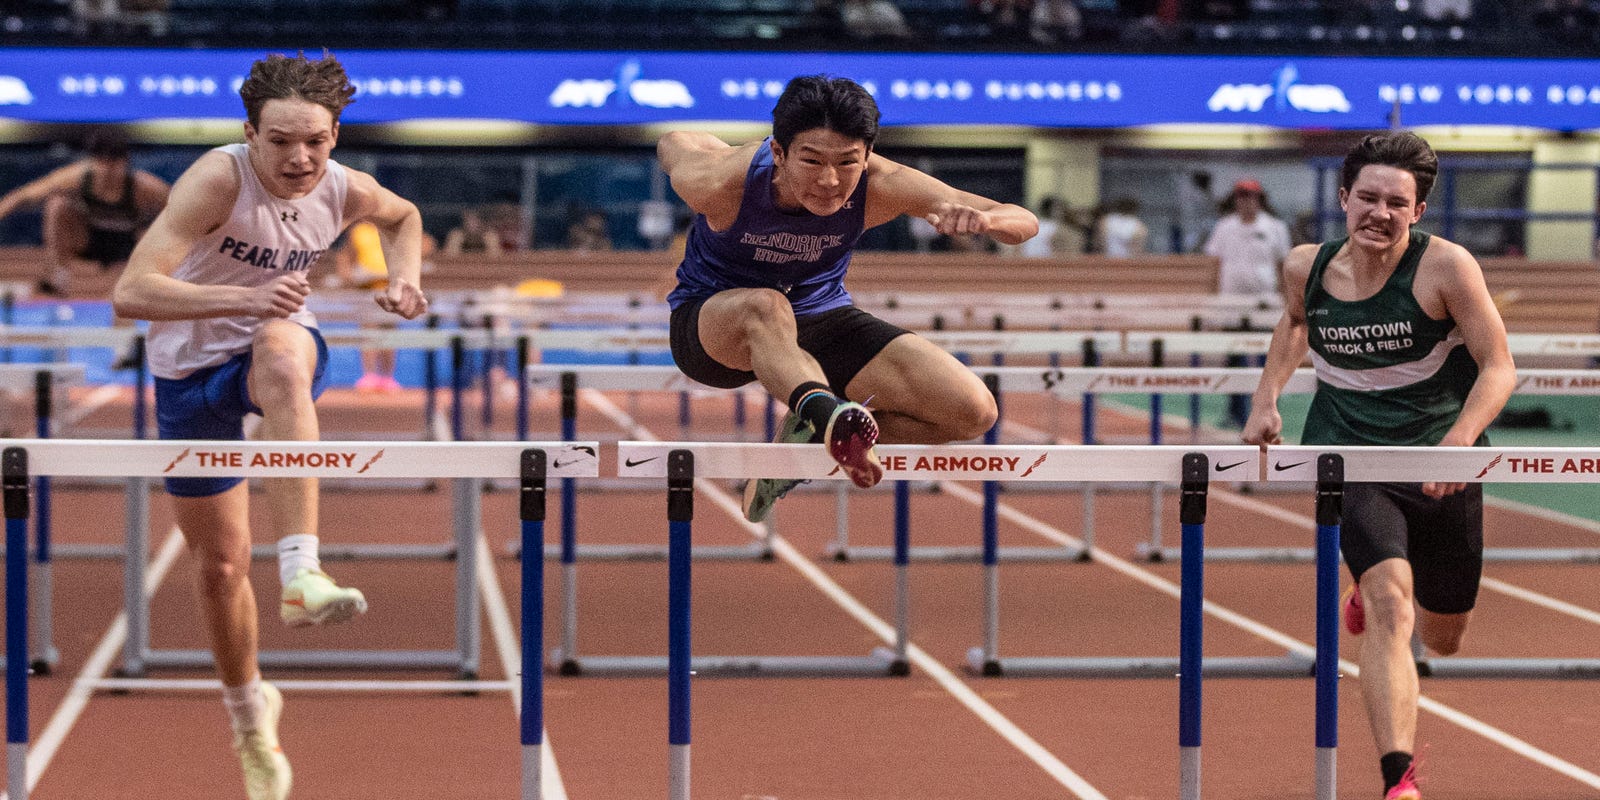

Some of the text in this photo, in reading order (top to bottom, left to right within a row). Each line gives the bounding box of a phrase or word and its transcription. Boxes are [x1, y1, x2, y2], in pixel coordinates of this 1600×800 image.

[740, 232, 844, 253] HENDRICK
[218, 236, 279, 269] PEARL
[753, 248, 823, 263] HUDSON
[1318, 321, 1412, 340] YORKTOWN
[1323, 338, 1413, 354] TRACK & FIELD
[1109, 375, 1211, 387] THE ARMORY
[1535, 376, 1563, 387] THE
[196, 452, 357, 468] THE ARMORY
[879, 456, 1020, 471] HE ARMORY
[1508, 458, 1600, 473] THE AR
